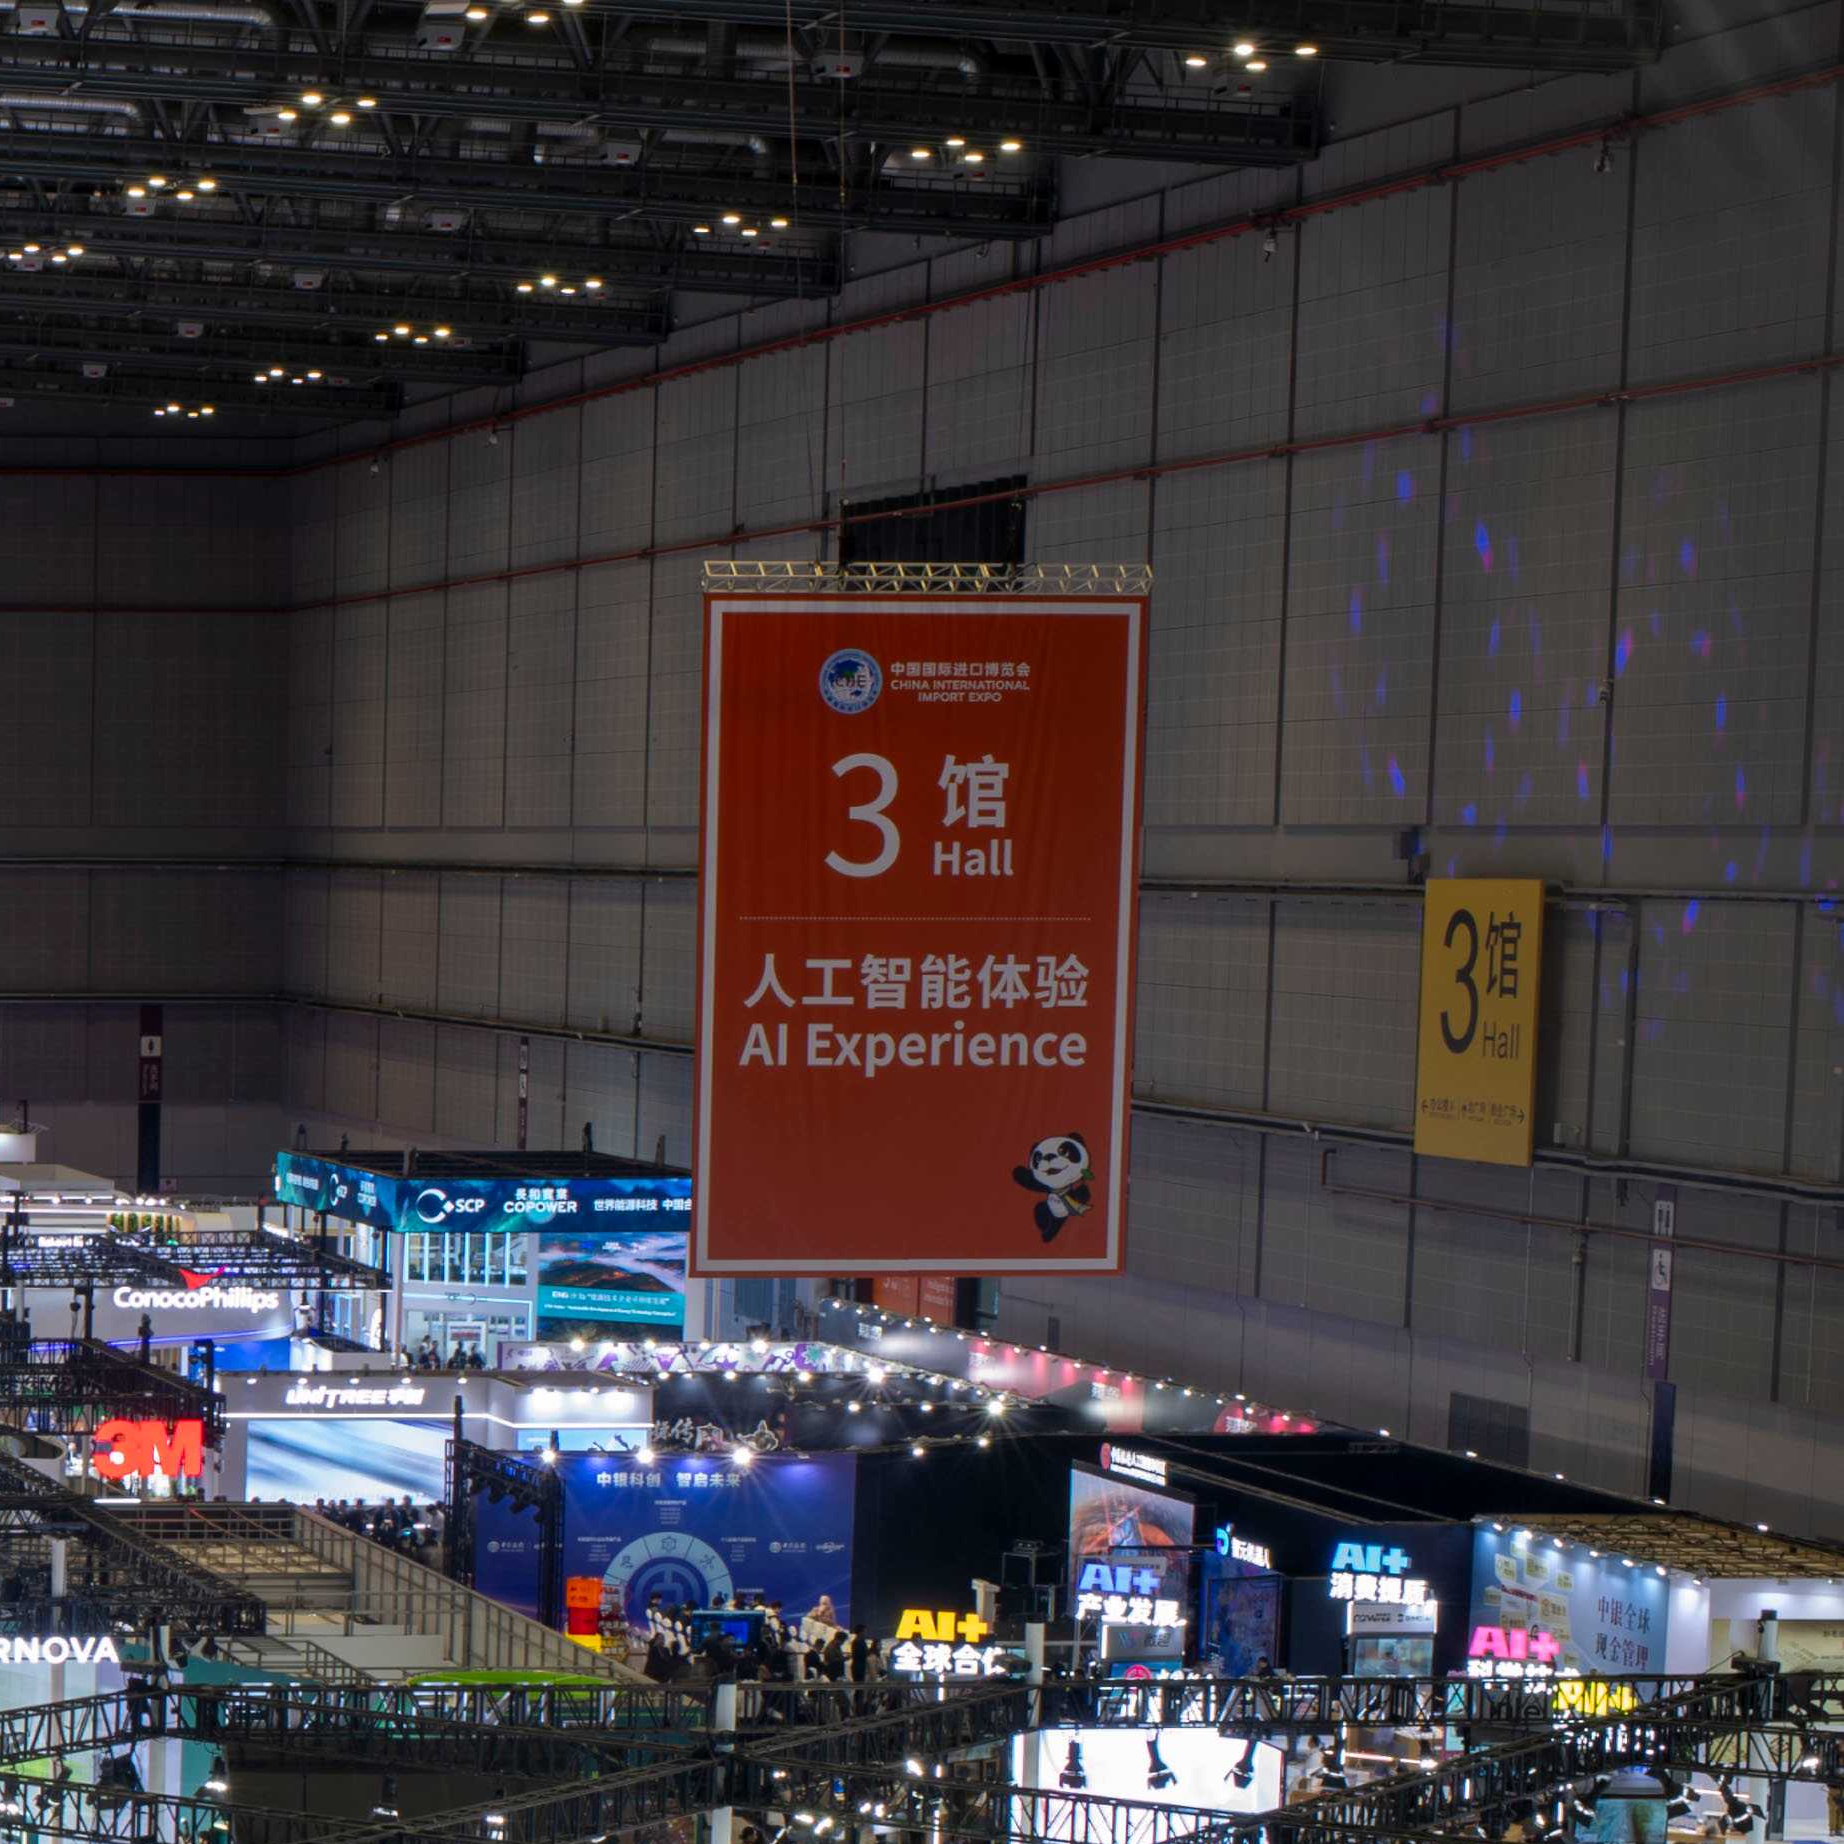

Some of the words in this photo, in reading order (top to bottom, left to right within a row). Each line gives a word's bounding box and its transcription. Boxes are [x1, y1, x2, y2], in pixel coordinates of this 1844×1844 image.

[890, 661, 1031, 678] 中国国际进口博览会
[891, 680, 929, 690] CHINA
[933, 680, 1030, 691] INTERNATIONAL
[918, 692, 965, 702] IMPORT
[968, 692, 1001, 702] EXPO
[824, 753, 901, 878] 3
[938, 754, 1010, 830] 馆
[933, 840, 1014, 877] Hall
[743, 953, 1089, 1012] 人工智能体验
[1440, 908, 1479, 1054] 3
[1485, 911, 1522, 999] 馆
[739, 1024, 788, 1067] AI
[807, 1021, 1086, 1078] Experience
[1482, 1021, 1520, 1060] Hall
[456, 1199, 485, 1213] SCP
[504, 1200, 577, 1214] COPOWER
[114, 1287, 279, 1313] ConocoPhillips
[91, 1419, 206, 1481] 3M
[597, 1471, 661, 1489] 中银科创
[676, 1471, 742, 1489] 智启未来
[1331, 1542, 1412, 1574] AI+
[1078, 1562, 1161, 1595] AI+
[895, 1609, 987, 1642] AI+
[1076, 1593, 1186, 1627] 产业发展
[1468, 1624, 1560, 1661] AI+
